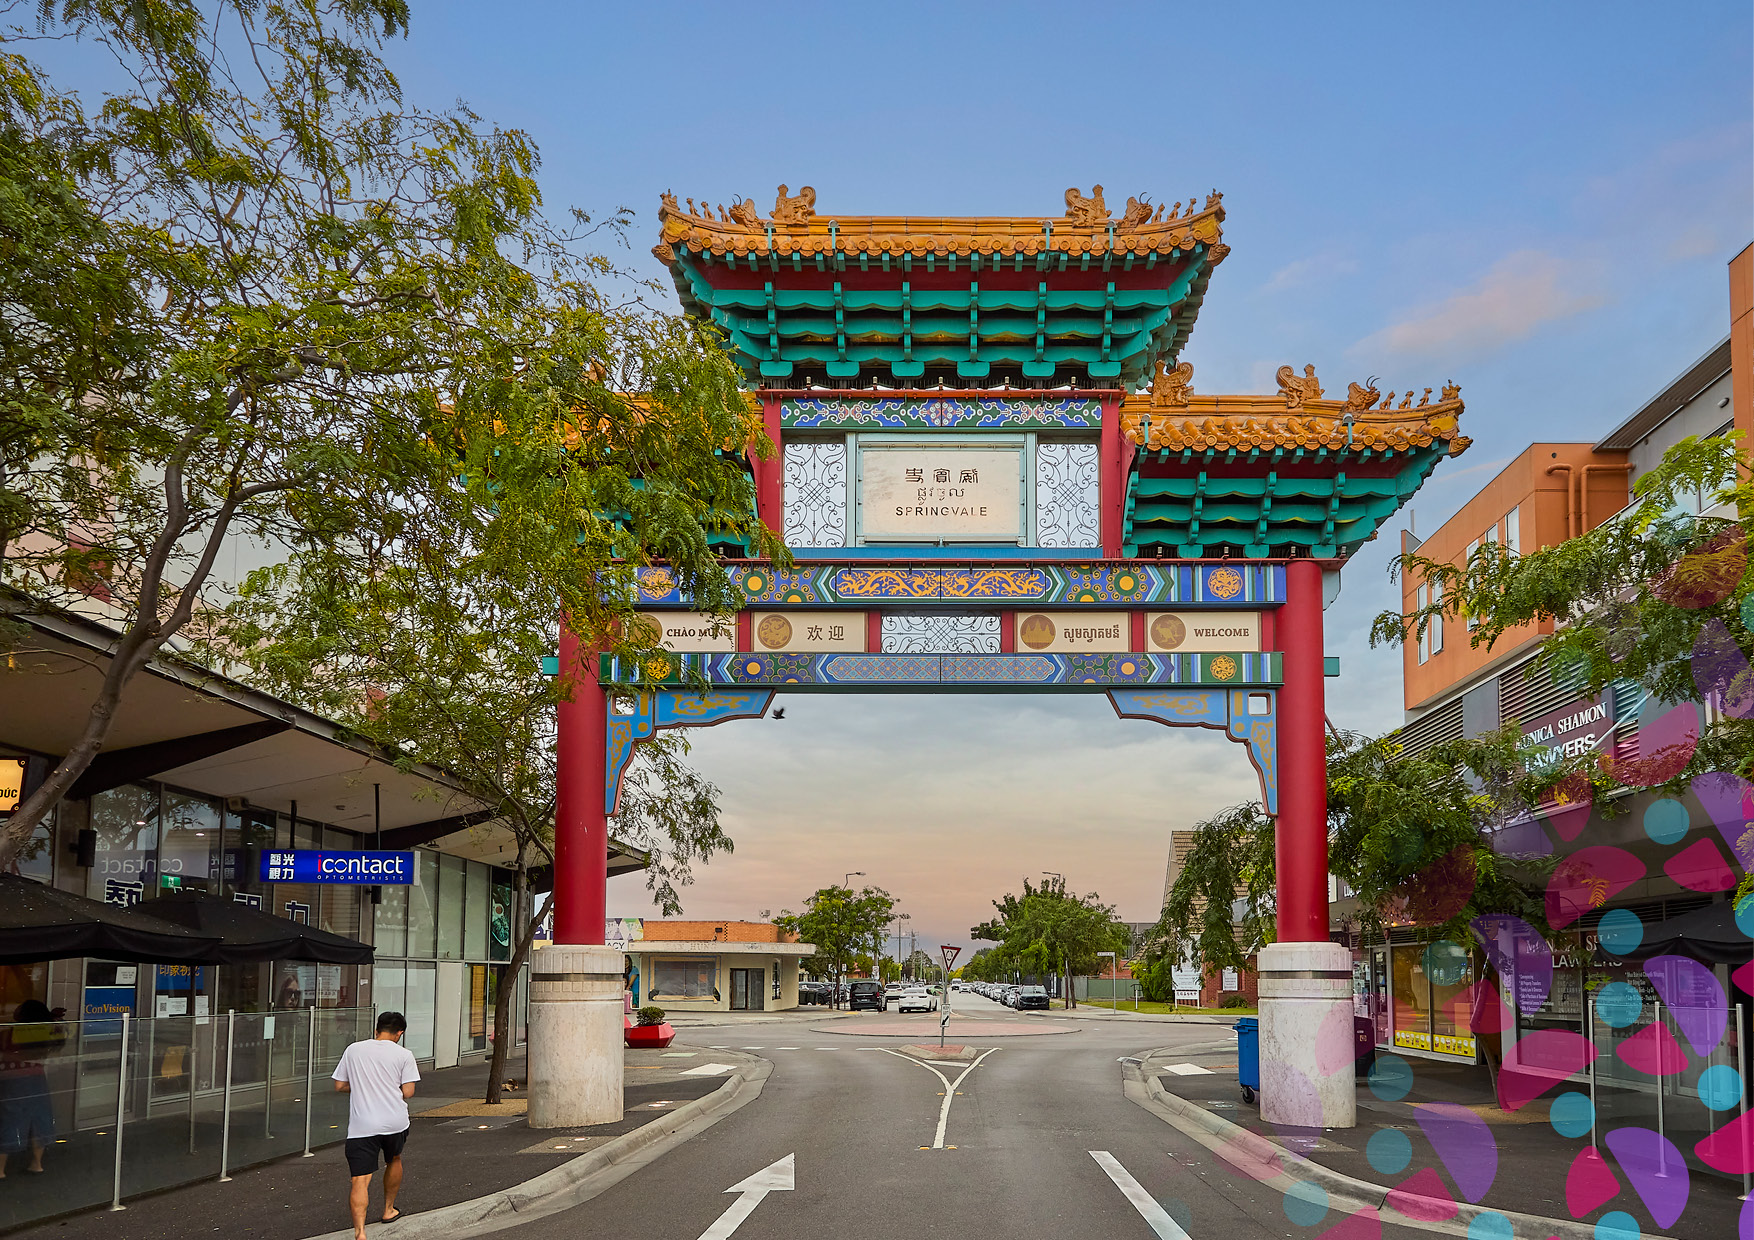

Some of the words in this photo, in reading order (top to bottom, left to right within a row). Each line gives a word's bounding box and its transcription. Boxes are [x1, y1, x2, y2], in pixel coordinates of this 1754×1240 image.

[895, 506, 988, 516] SPRINGVALE
[666, 626, 696, 637] CHÀO
[807, 625, 845, 642] 欢迎
[1193, 628, 1250, 637] WELCOME
[1557, 702, 1607, 735] SHAMON
[317, 854, 404, 874] icontact
[85, 1003, 130, 1014] ConVision
